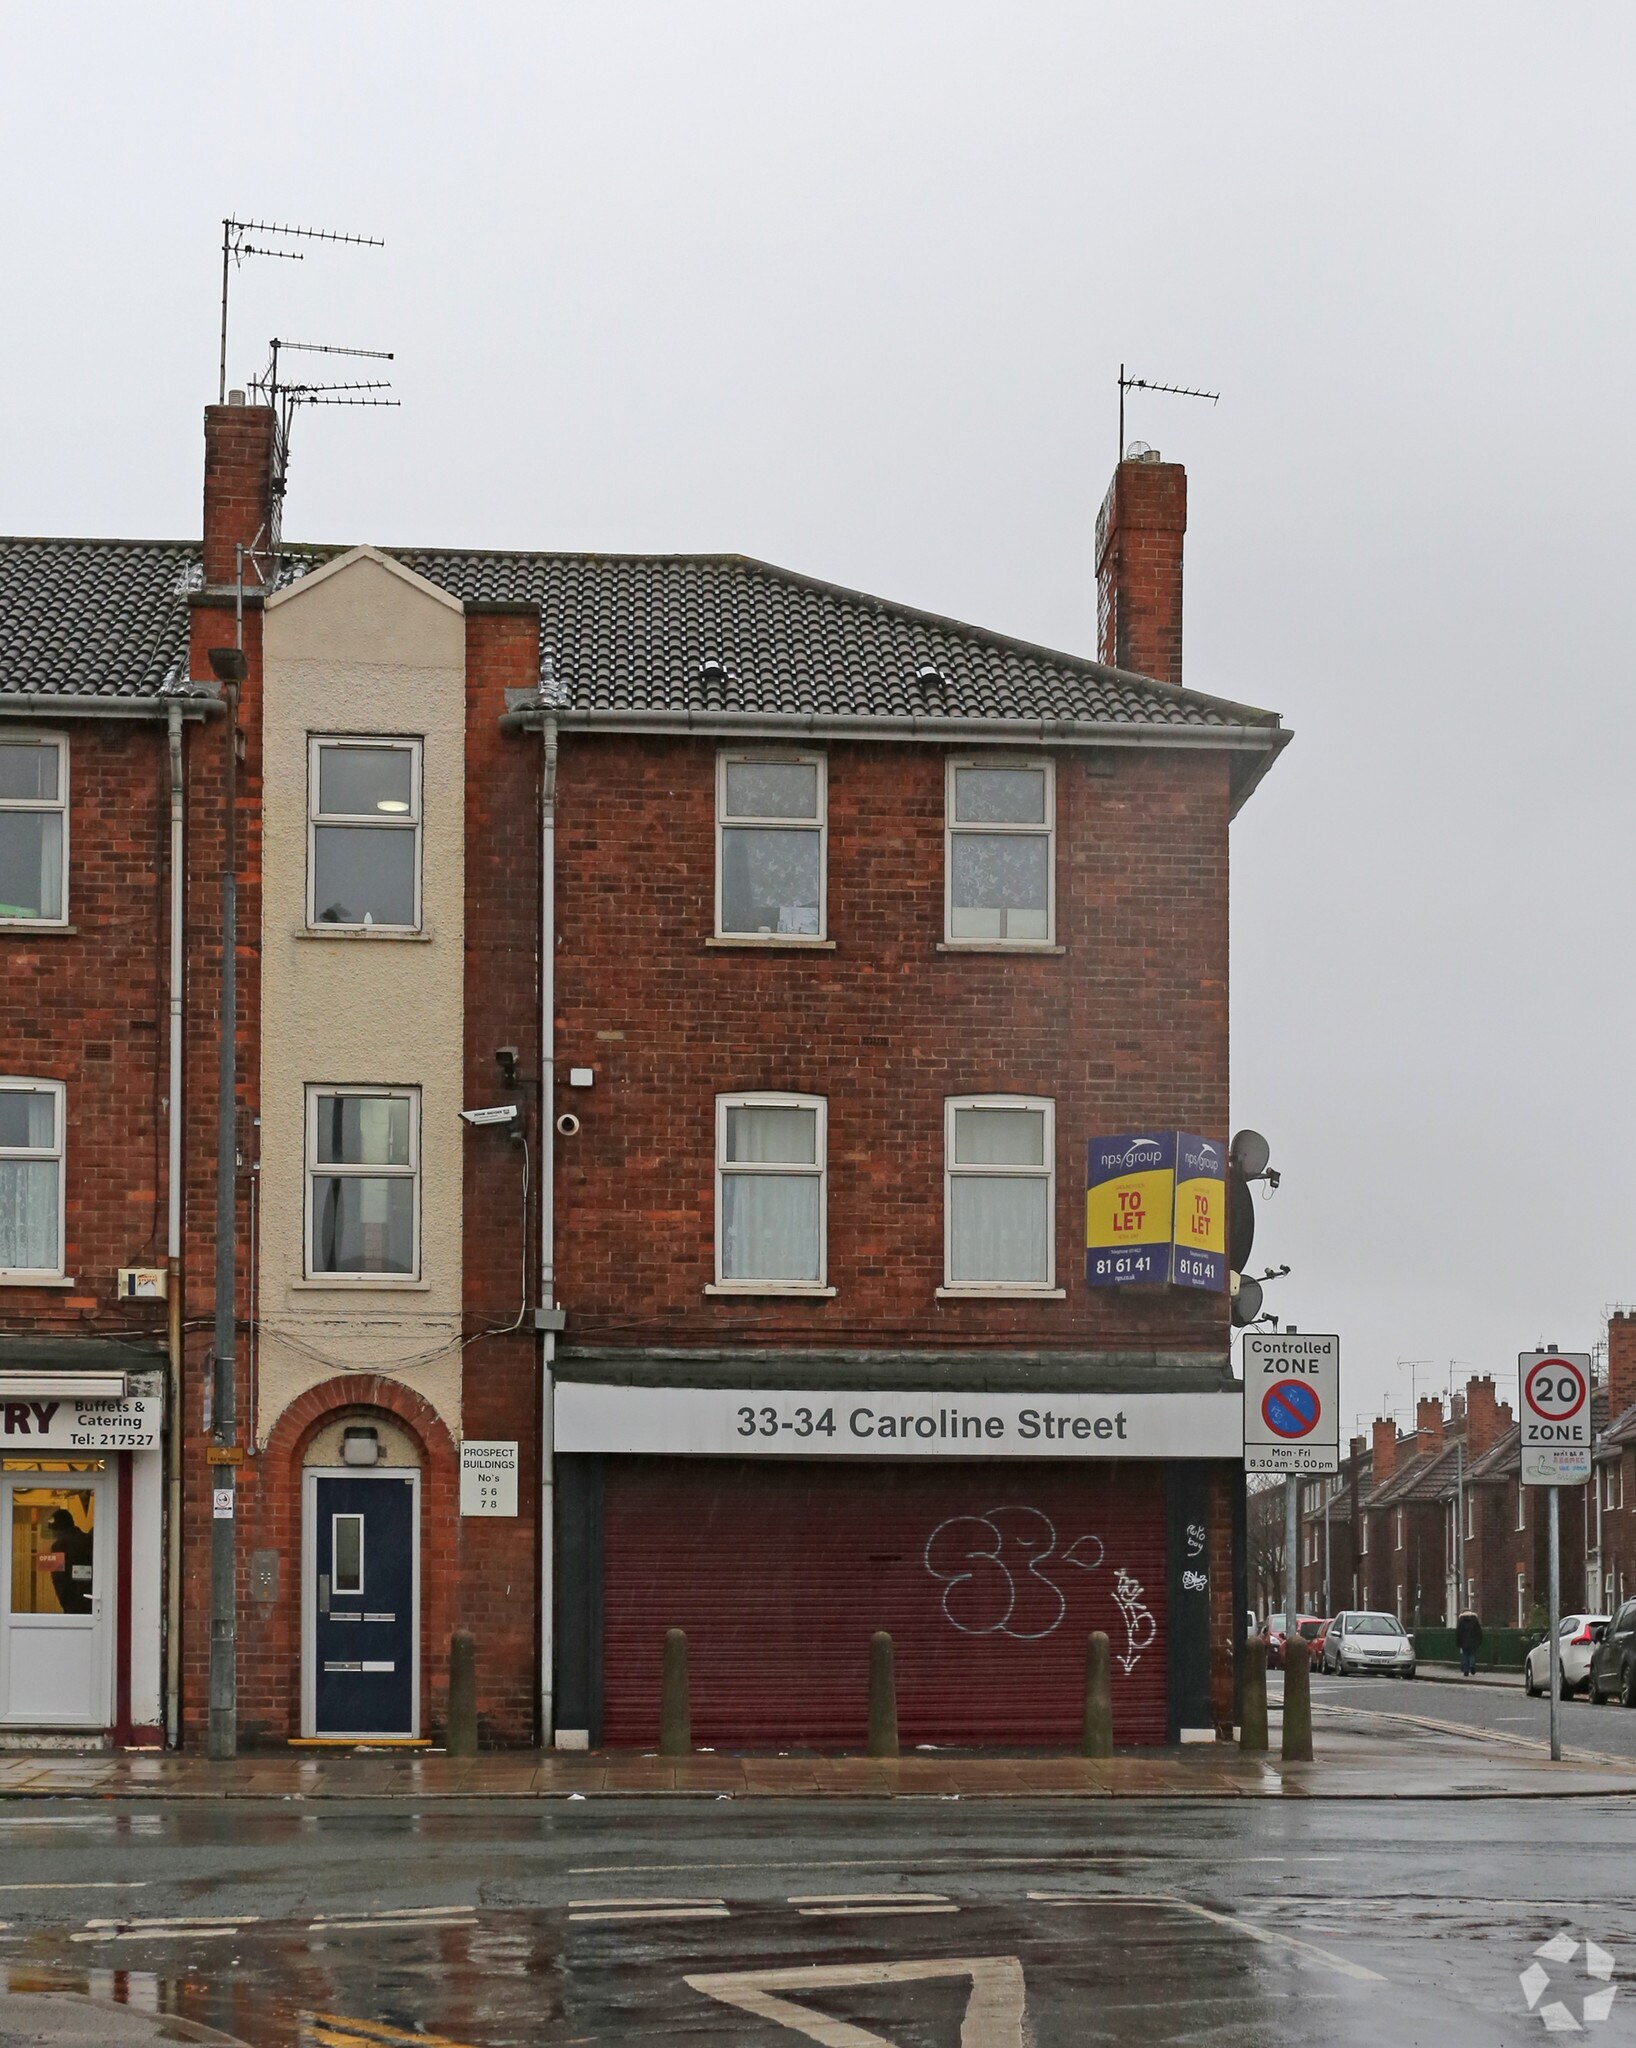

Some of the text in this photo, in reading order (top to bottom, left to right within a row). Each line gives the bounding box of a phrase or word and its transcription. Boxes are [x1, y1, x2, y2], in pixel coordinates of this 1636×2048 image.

[1118, 1191, 1142, 1211] TO
[1194, 1195, 1209, 1215] TO
[1112, 1210, 1146, 1231] LET
[1191, 1214, 1211, 1236] LET
[1096, 1256, 1151, 1274] 81 61 41
[1180, 1259, 1215, 1278] 81 61 41
[1251, 1340, 1331, 1354] Controlled
[1263, 1358, 1320, 1374] ZONE
[1535, 1377, 1577, 1402] 20
[75, 1400, 129, 1413] Buffets
[134, 1401, 145, 1413] &
[77, 1414, 142, 1429] Catering
[737, 1406, 1128, 1440] 33-34 Caroline Street
[70, 1434, 154, 1446] Tel: 217527
[1528, 1425, 1583, 1441] ZONE
[464, 1449, 514, 1457] PROSPECT
[463, 1460, 515, 1469] BUILDINGS
[478, 1474, 500, 1482] No's
[481, 1487, 497, 1496] 5 6
[480, 1499, 497, 1509] 7 8
